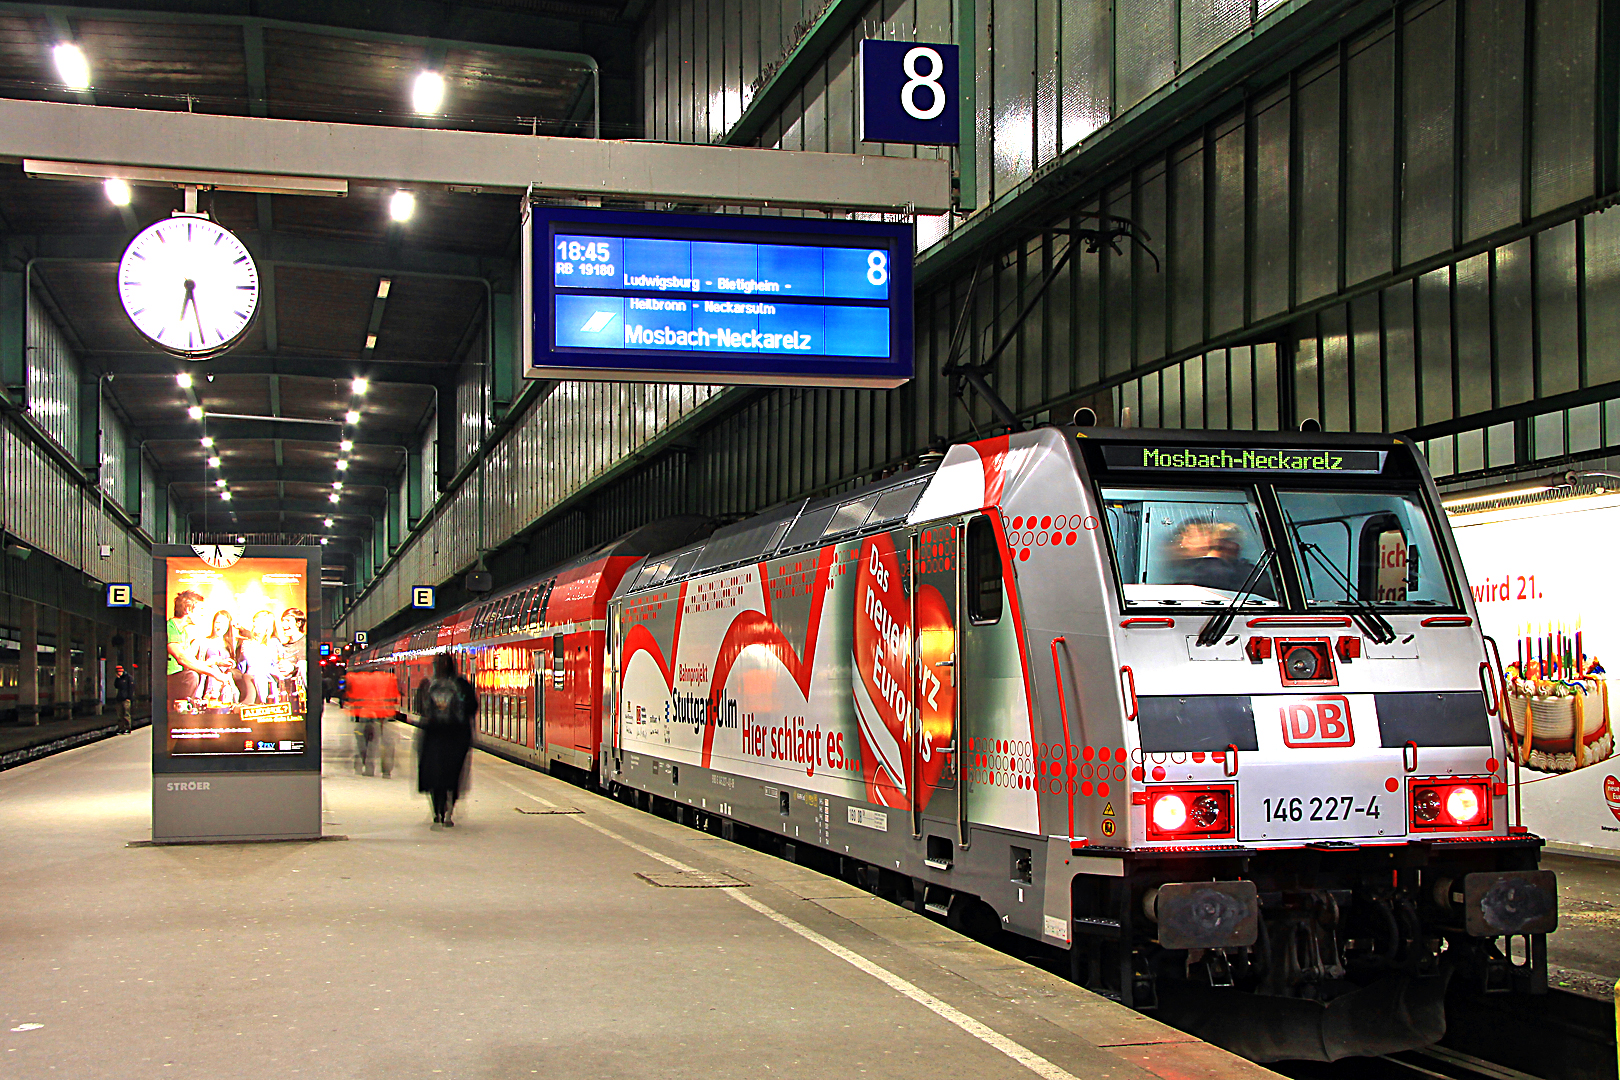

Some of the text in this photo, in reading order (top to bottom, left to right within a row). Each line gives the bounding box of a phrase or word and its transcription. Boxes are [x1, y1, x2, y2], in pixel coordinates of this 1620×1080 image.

[901, 47, 946, 120] 8
[557, 241, 610, 262] 18:45
[556, 262, 615, 276] RB 19180
[867, 250, 888, 286] 8
[624, 274, 700, 292] Ludwigsburg
[718, 277, 780, 293] Bietigheim
[630, 298, 687, 312] Heilbronn
[705, 301, 776, 315] Neckarsulm
[625, 324, 811, 350] Mosbach-Neckarelz
[1143, 448, 1343, 470] Mosbach-Neckarelz
[869, 543, 890, 593] Das
[113, 588, 125, 602] E
[418, 591, 429, 604] E
[1470, 575, 1543, 603] wird 21.
[865, 584, 900, 657] neue
[358, 633, 365, 641] D
[678, 663, 709, 687] Bahnprojekt
[672, 687, 738, 735] Stuttgart-Ulm
[1289, 704, 1346, 739] DB
[742, 713, 860, 777] Hier schlägt es...
[166, 781, 211, 791] STRÖER
[1263, 795, 1381, 822] 146 227-4
